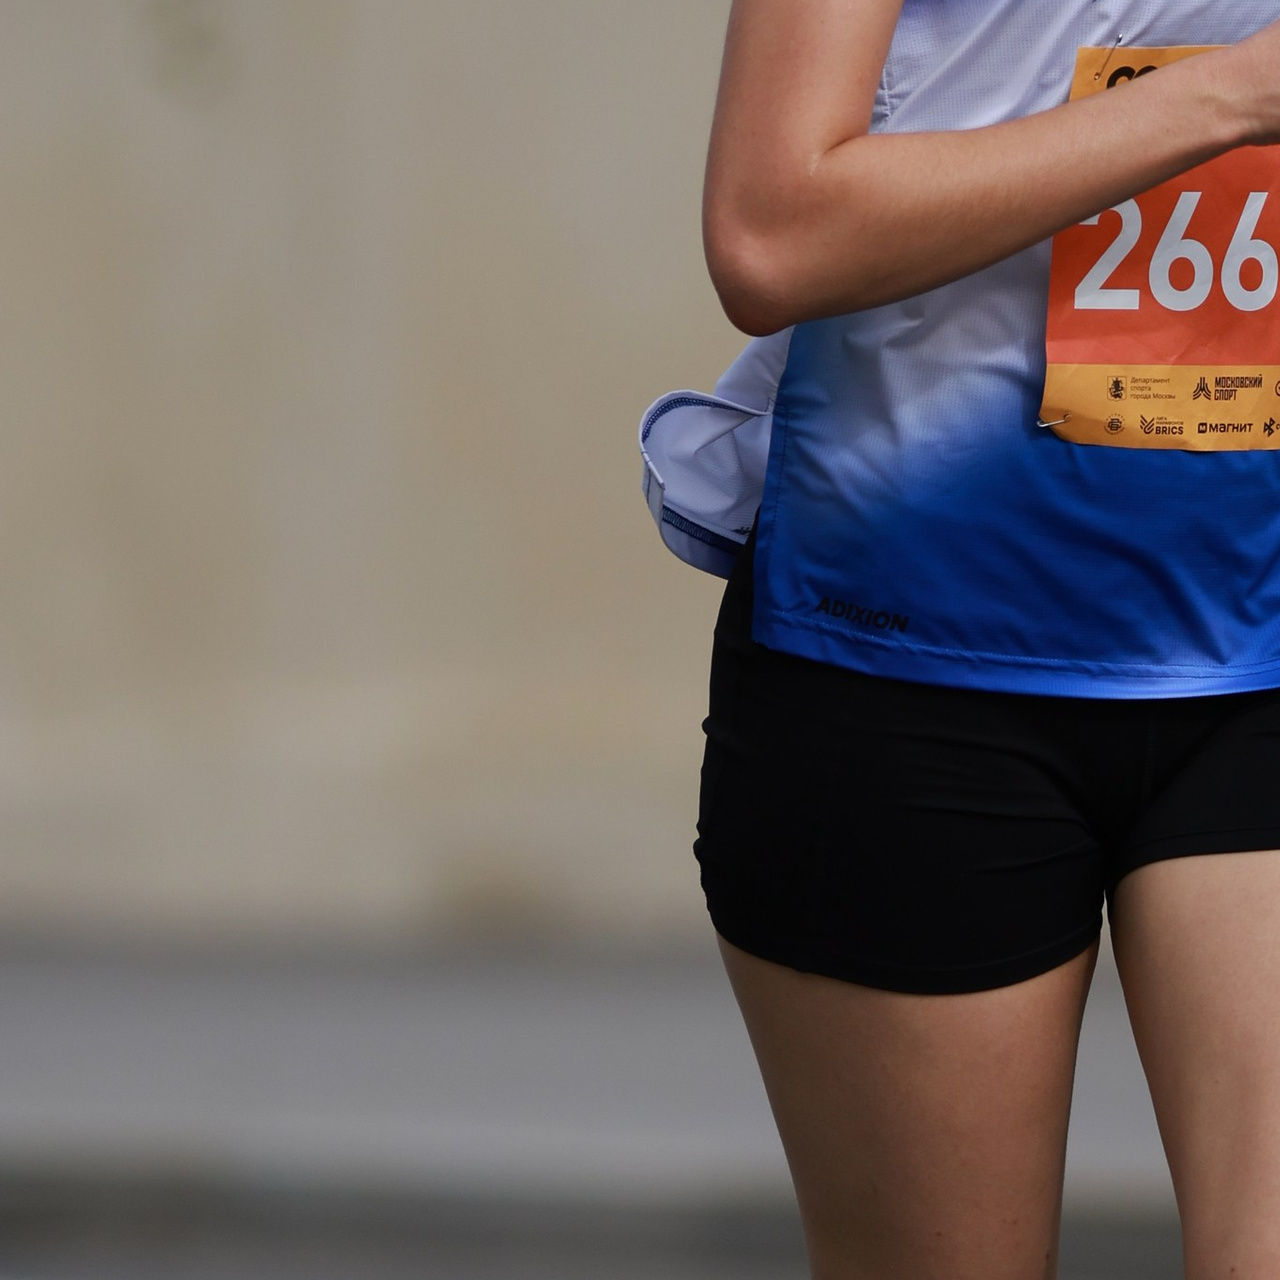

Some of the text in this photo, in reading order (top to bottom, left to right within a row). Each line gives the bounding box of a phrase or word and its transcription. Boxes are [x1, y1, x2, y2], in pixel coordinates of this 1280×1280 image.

[1130, 376, 1171, 385] Департамент
[1214, 374, 1263, 389] МОСКОВСКИЙ
[1130, 385, 1151, 393] спорта
[1214, 389, 1238, 401] СПОРТ
[1155, 426, 1184, 435] BRICS
[815, 597, 909, 632] ADIXION
